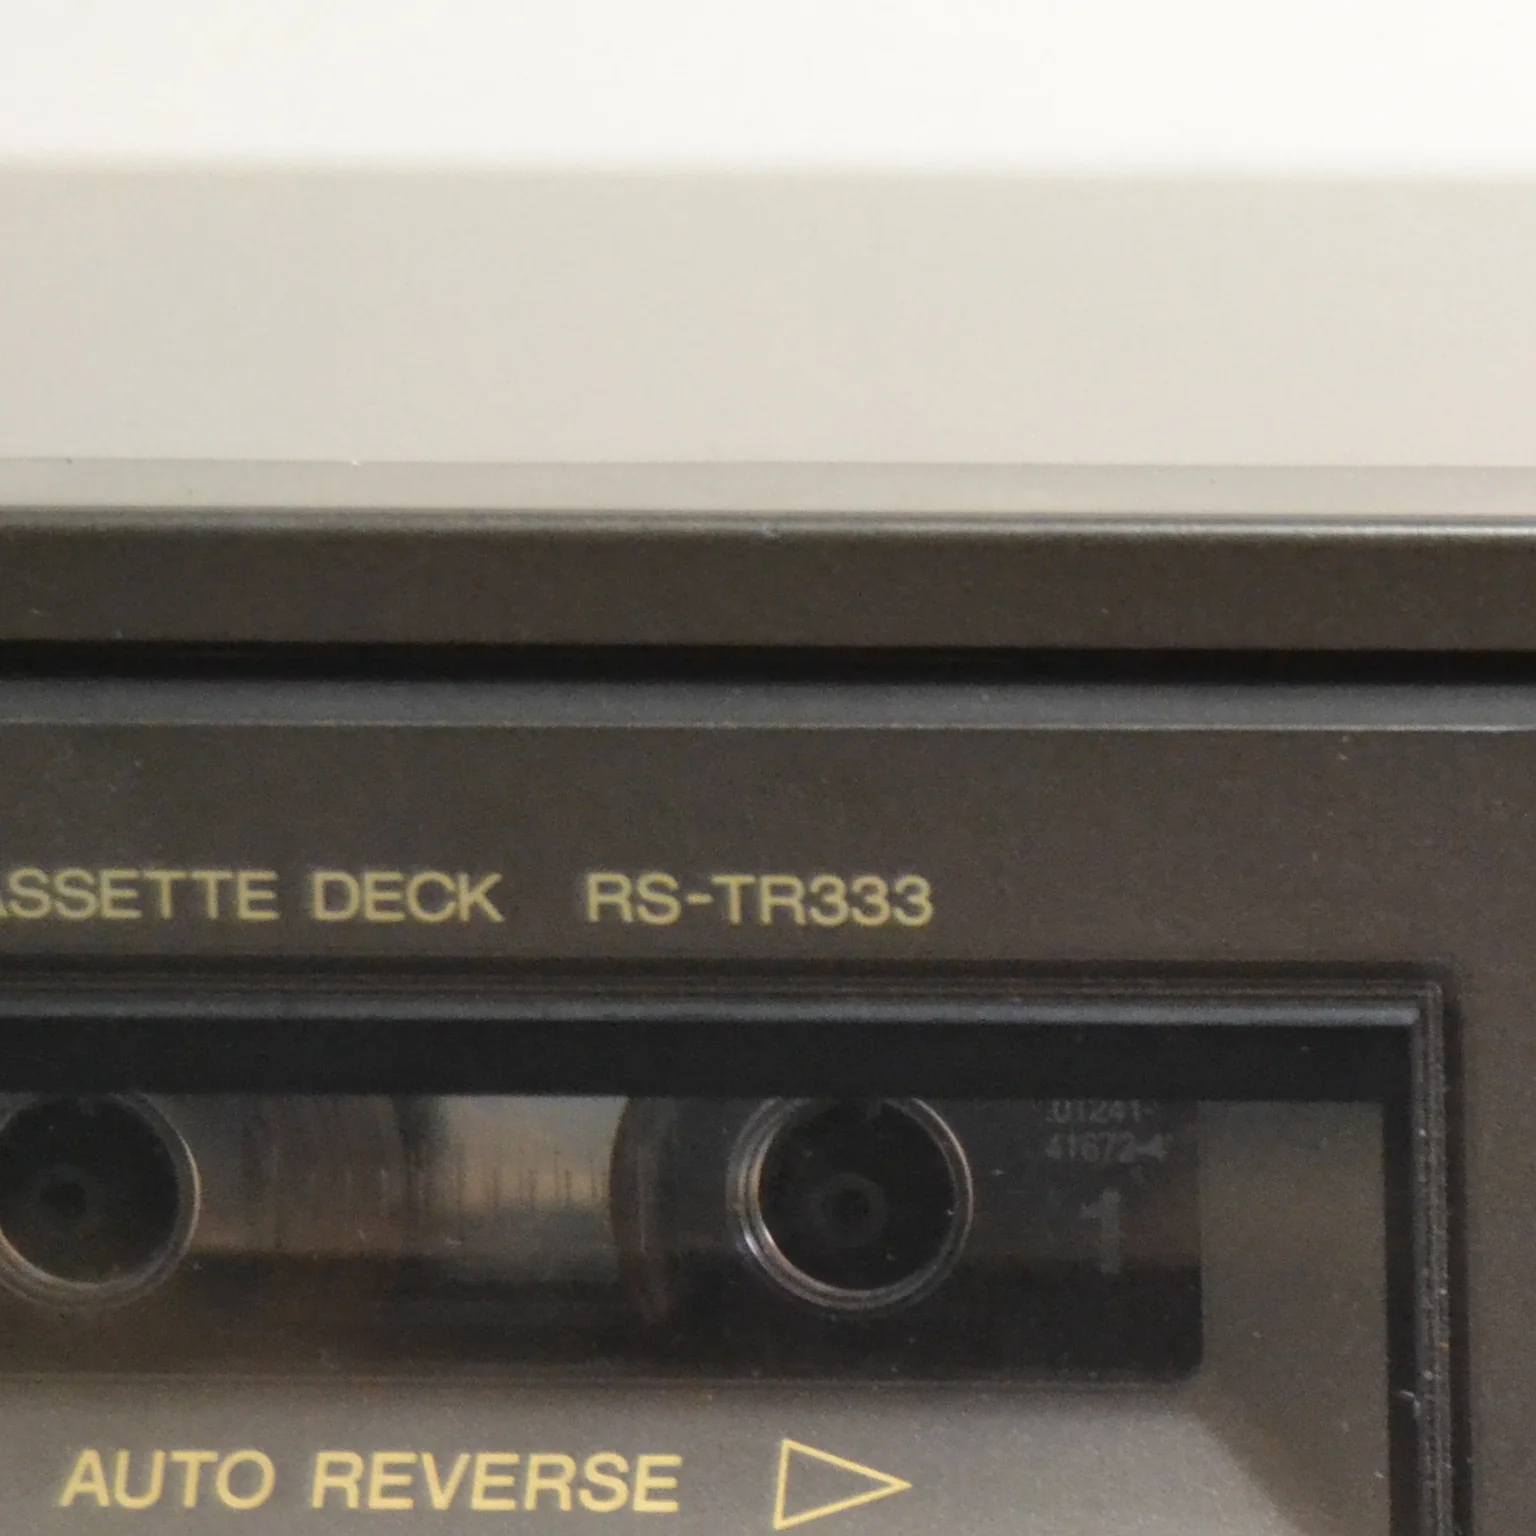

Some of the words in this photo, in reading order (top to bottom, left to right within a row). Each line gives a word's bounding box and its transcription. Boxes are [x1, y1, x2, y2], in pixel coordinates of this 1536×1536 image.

[0, 867, 279, 922] SSETTE
[311, 869, 504, 923] DECK
[586, 871, 934, 927] RS-TR333
[58, 1449, 276, 1511] AUTO
[311, 1451, 682, 1514] REVERSE
